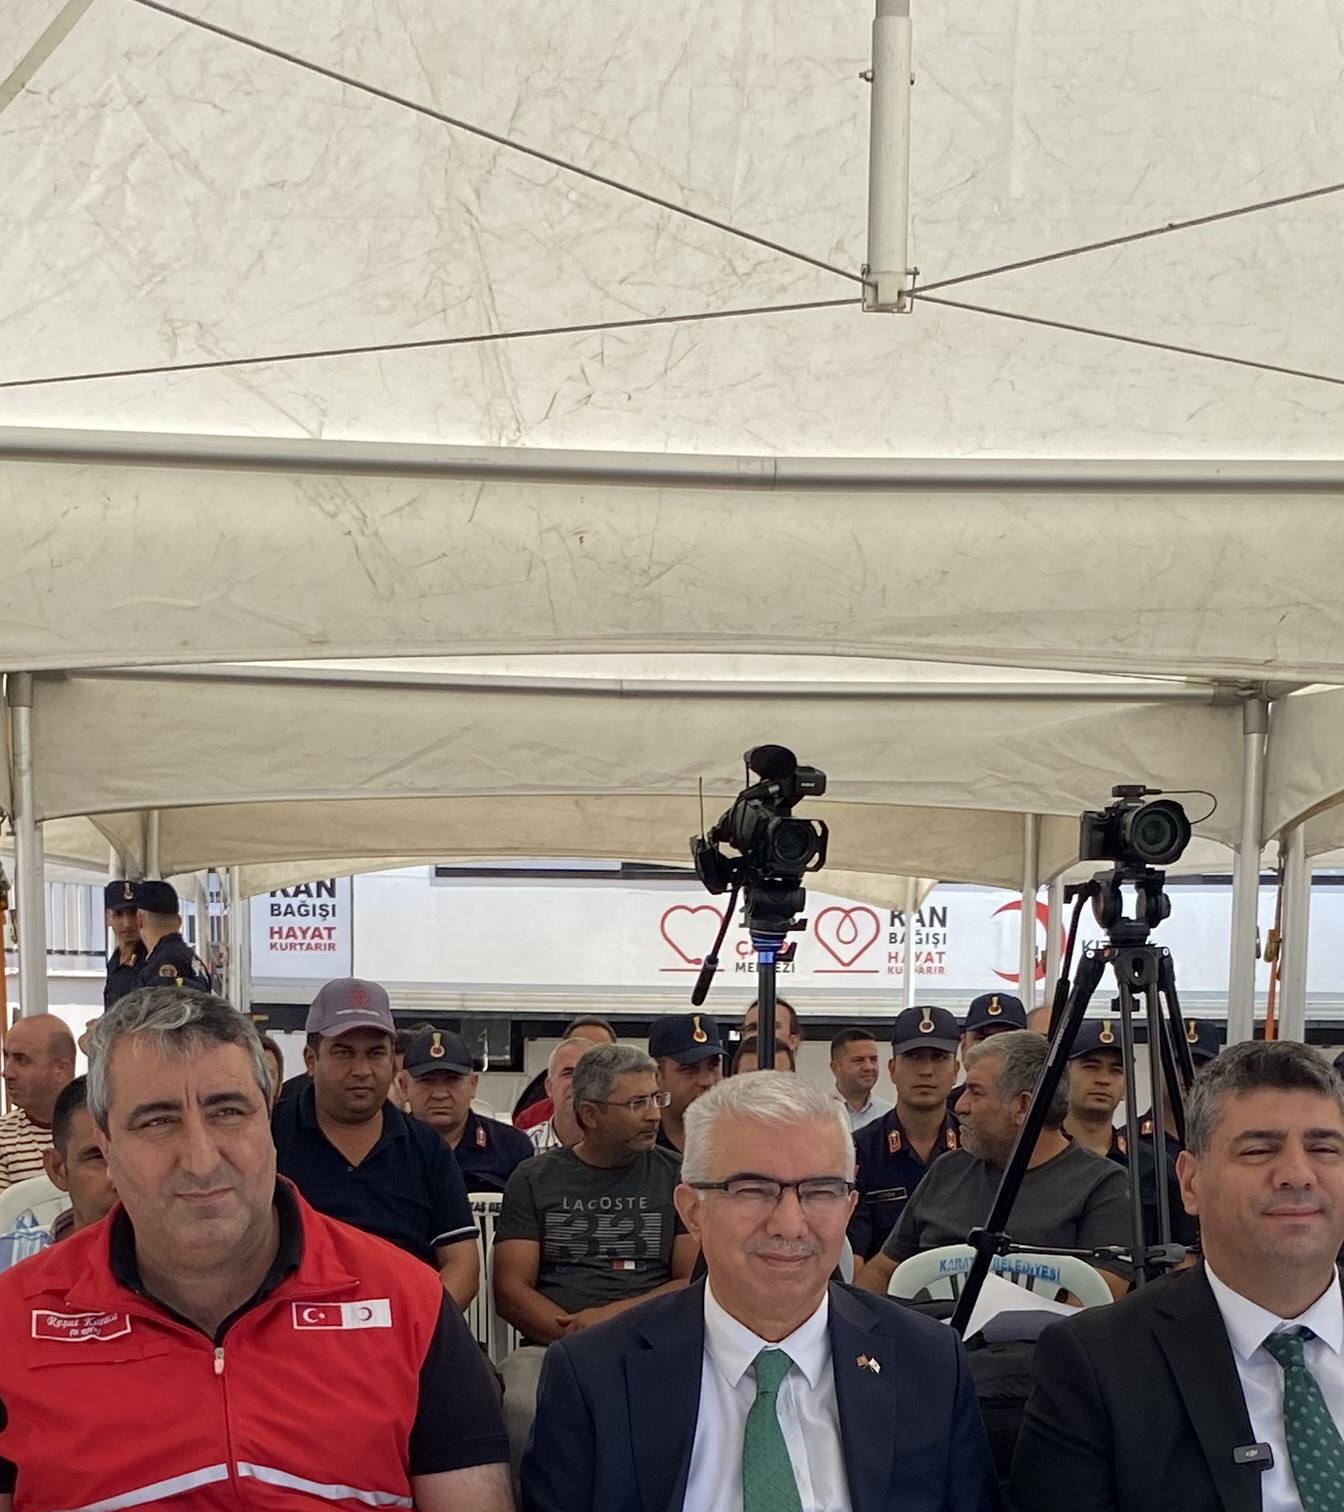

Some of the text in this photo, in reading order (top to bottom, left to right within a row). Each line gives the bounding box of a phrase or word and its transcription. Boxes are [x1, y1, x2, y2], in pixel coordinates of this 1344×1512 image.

[270, 900, 336, 921] BAĞIŞI
[269, 926, 337, 940] HAYAT
[269, 942, 336, 951] KURTARIR
[887, 951, 946, 964] HYAT
[887, 966, 946, 975] KUARIR
[562, 1196, 648, 1211] LACOSTE
